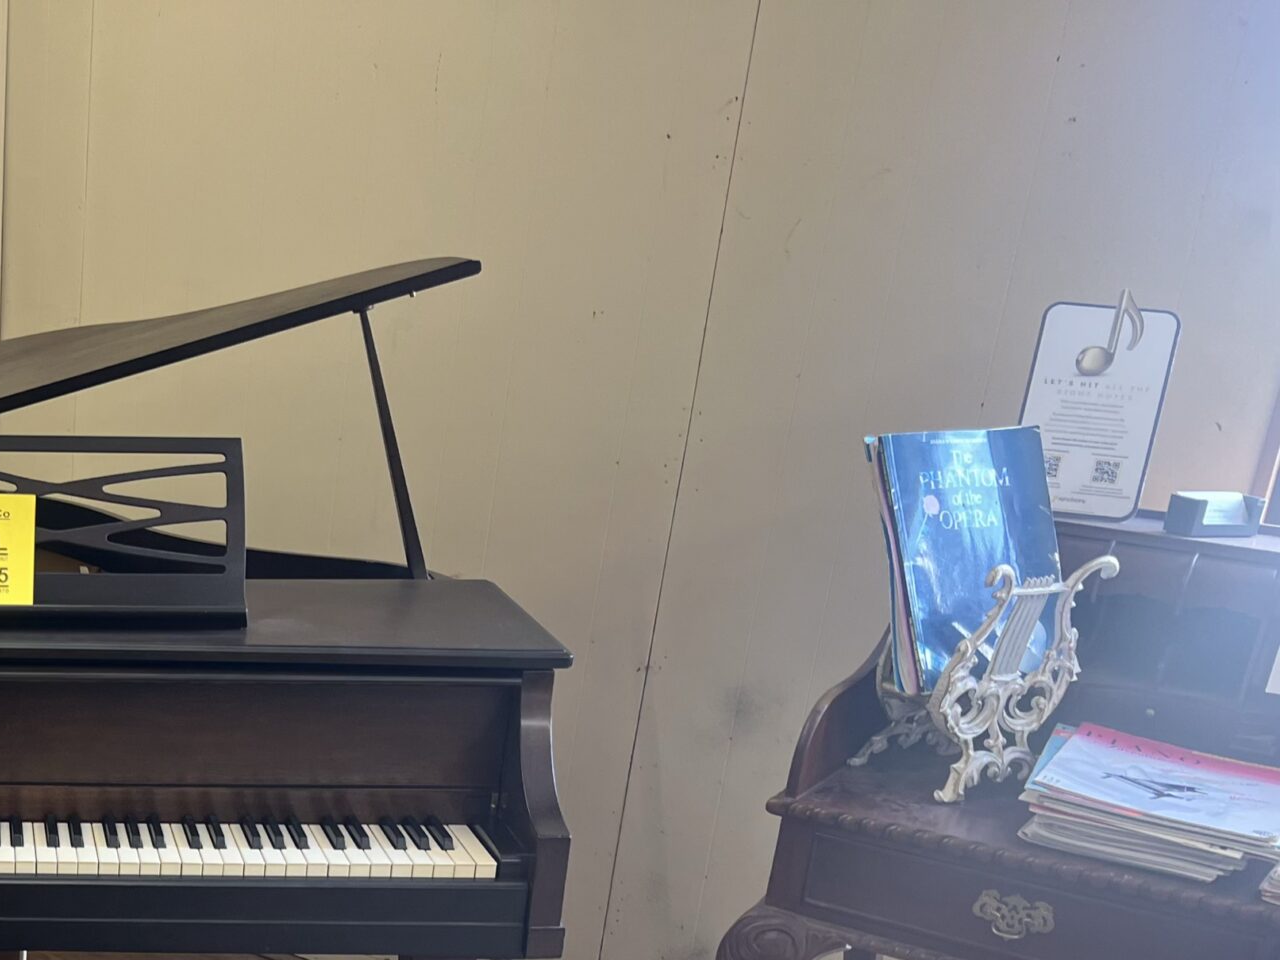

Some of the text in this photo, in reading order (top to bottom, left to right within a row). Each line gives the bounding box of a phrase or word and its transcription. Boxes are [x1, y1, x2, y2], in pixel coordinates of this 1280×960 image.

[918, 466, 1011, 489] PHANTOM
[952, 489, 983, 506] of the
[939, 508, 999, 530] OPERA
